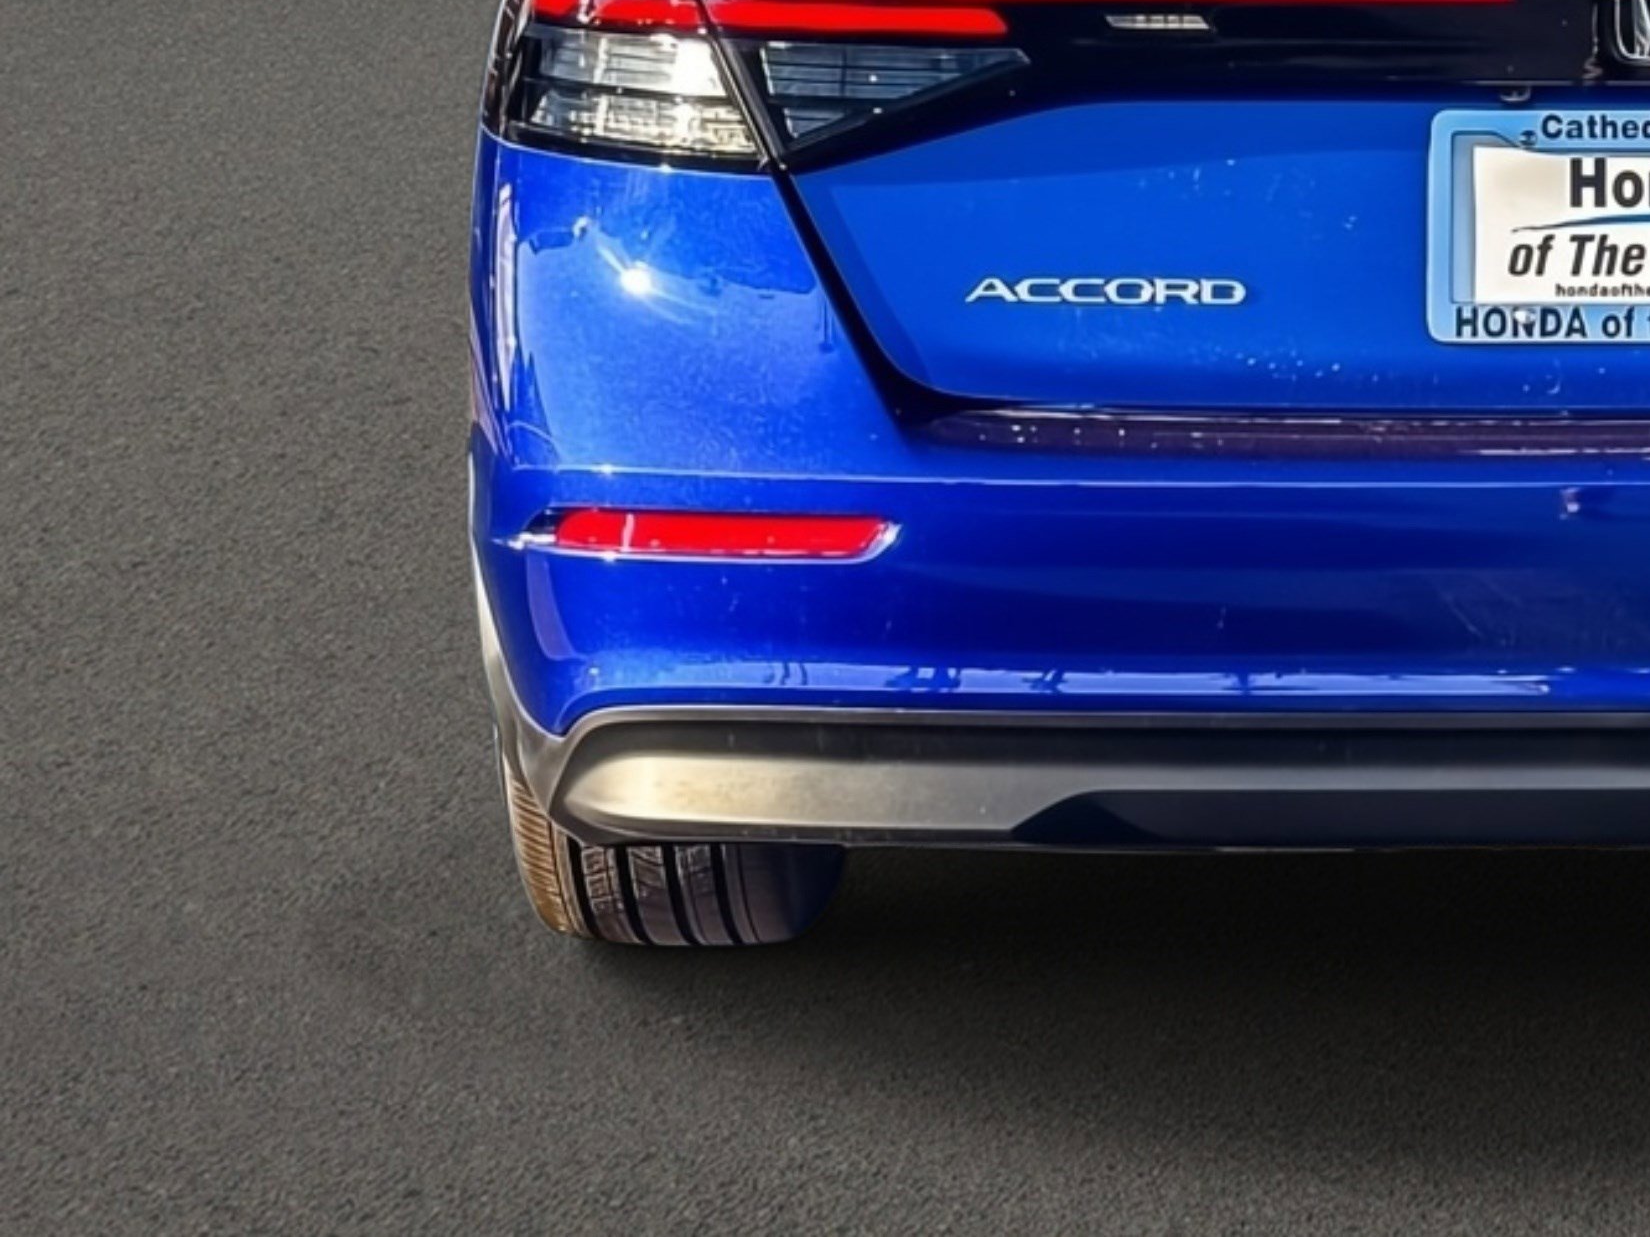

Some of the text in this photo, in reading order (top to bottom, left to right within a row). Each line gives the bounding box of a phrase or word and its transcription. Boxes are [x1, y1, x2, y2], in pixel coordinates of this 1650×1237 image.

[1507, 234, 1555, 276] of
[1569, 234, 1647, 276] The
[965, 277, 1247, 305] ACCORD
[1454, 307, 1588, 339] HONDA
[1601, 307, 1635, 339] of
